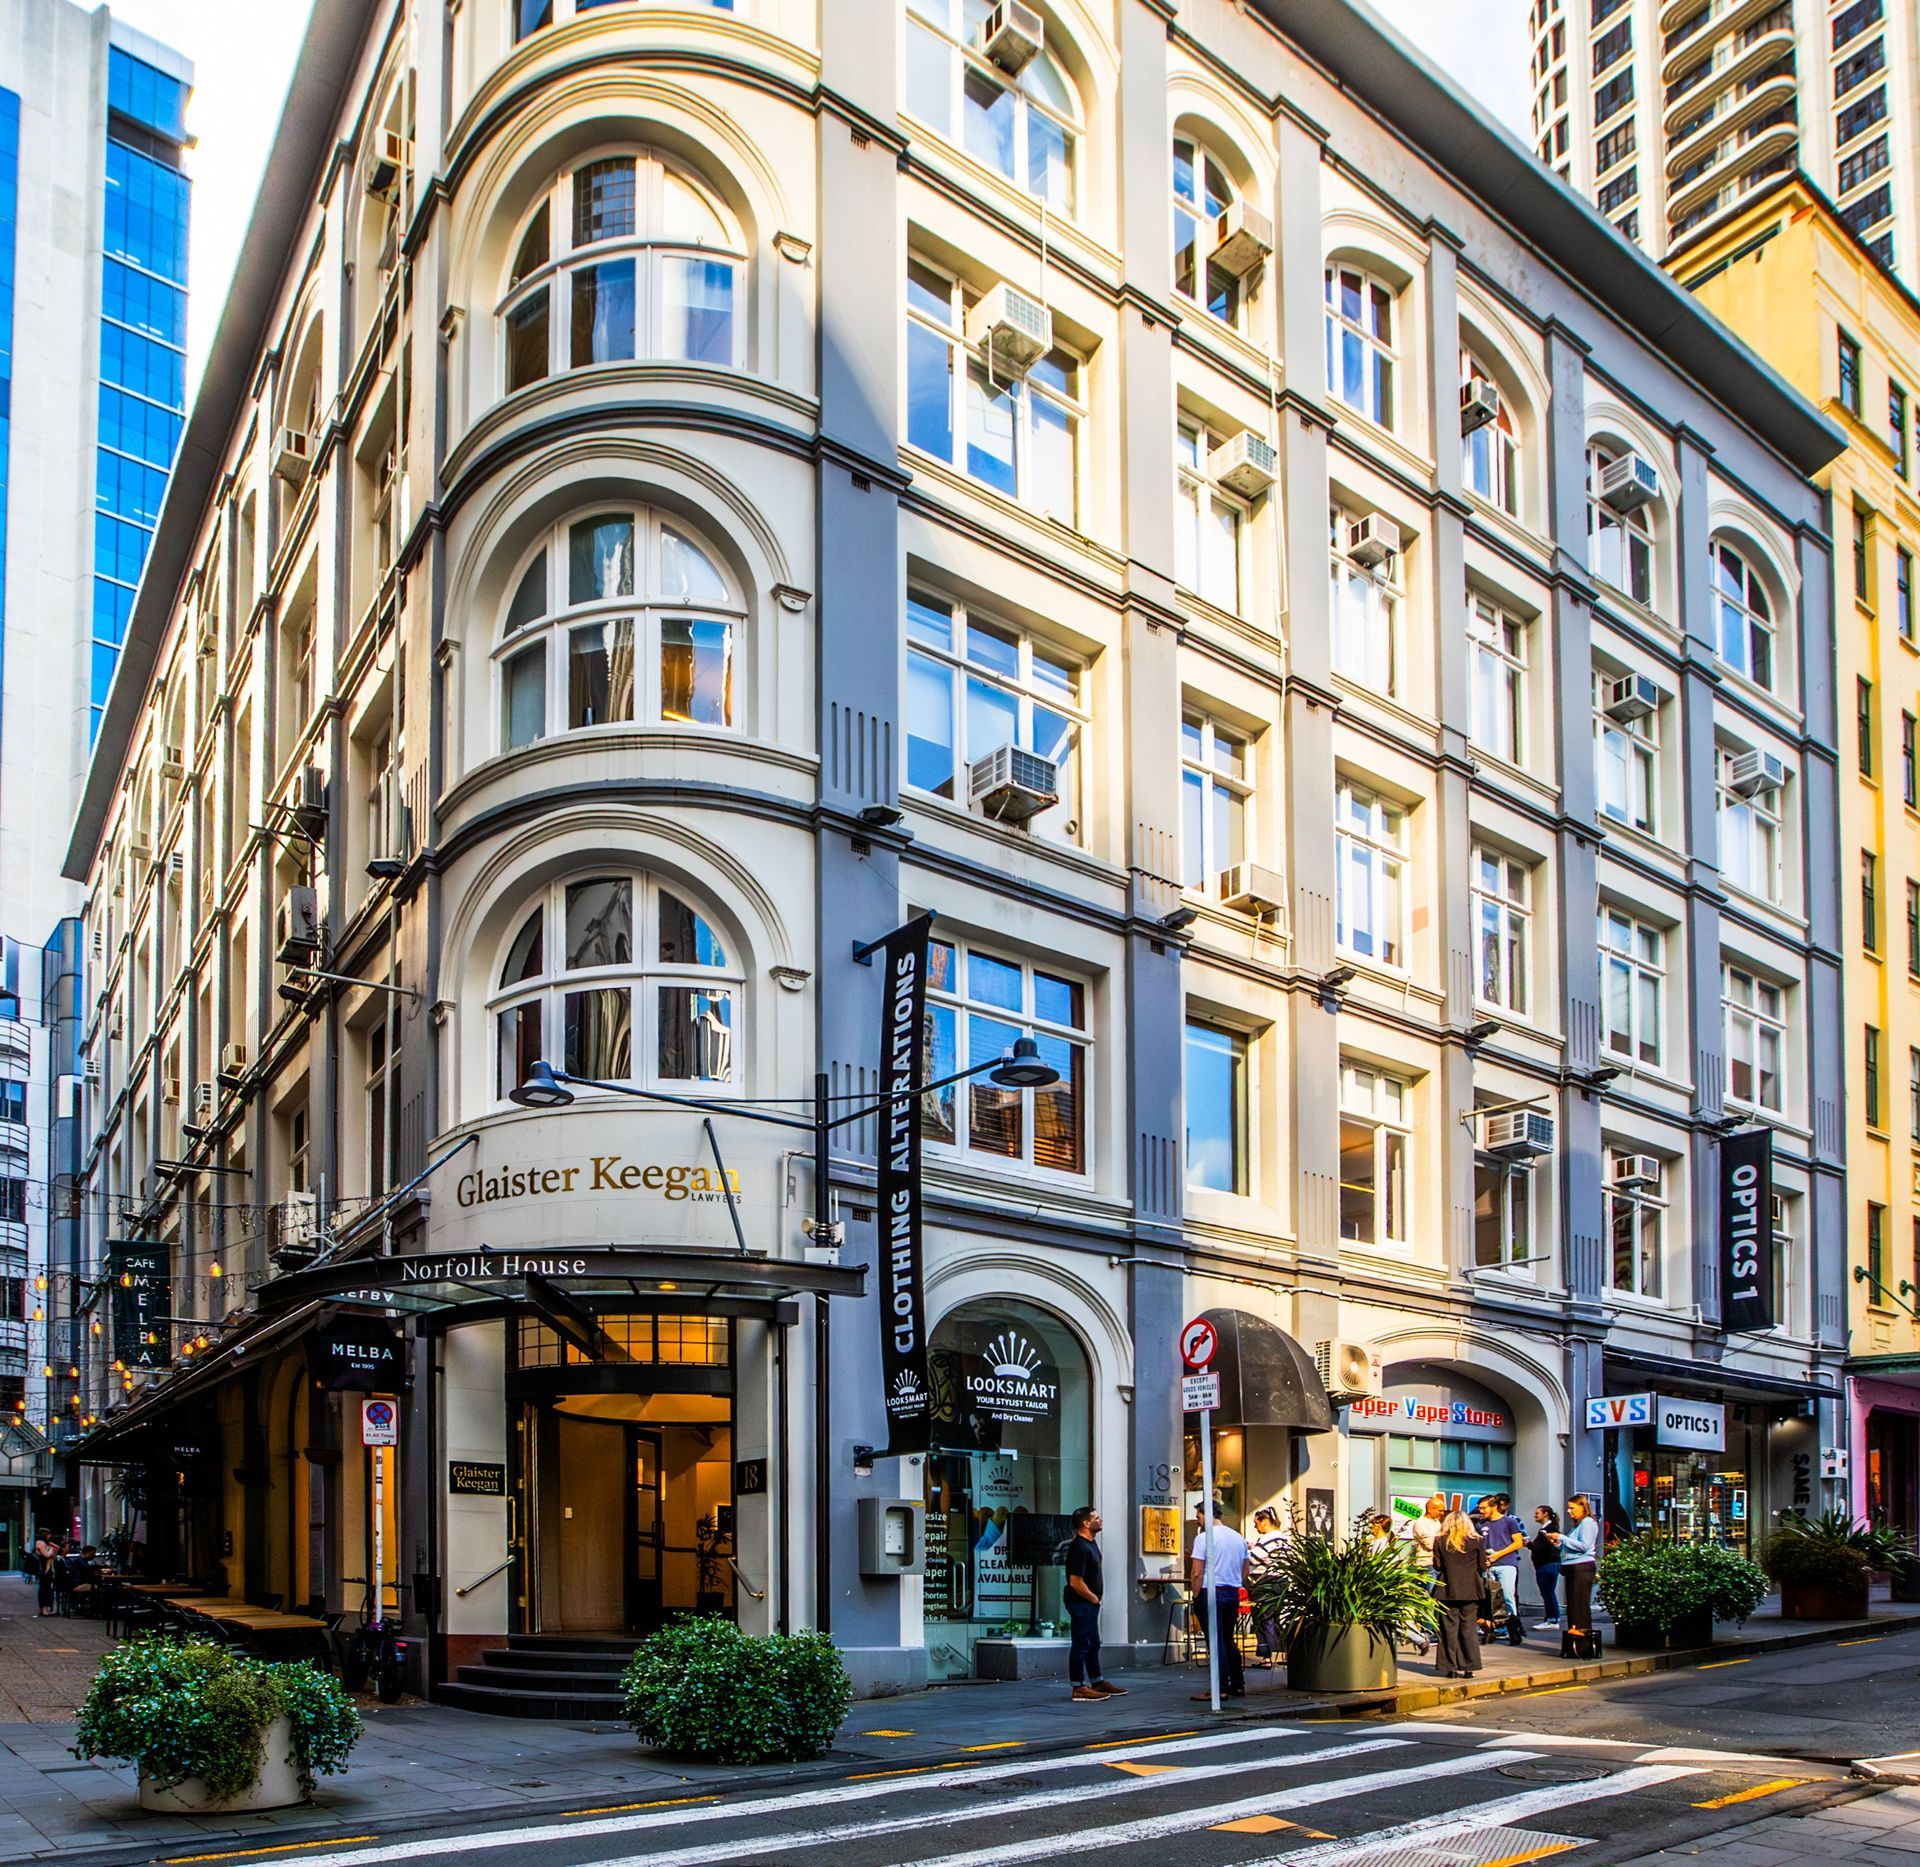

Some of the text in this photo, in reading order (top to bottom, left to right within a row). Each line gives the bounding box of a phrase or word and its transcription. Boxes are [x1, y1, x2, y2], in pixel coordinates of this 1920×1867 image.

[890, 951, 916, 1354] CLOTHING ALTERATIONS
[457, 1156, 742, 1208] Glaister Keegan
[1732, 1164, 1759, 1300] OPTICS 1
[126, 1258, 156, 1269] CAFE
[401, 1255, 586, 1281] Norfolk House
[134, 1274, 152, 1364] MELBA
[332, 1343, 393, 1360] MELBA
[966, 1375, 1057, 1399] LOOKSMART
[886, 1392, 928, 1406] LOOKSMART
[976, 1396, 1048, 1410] YOUR STYLIST TAILOR
[1003, 1414, 1012, 1422] Dry
[1014, 1414, 1034, 1422] Cleaner
[1351, 1396, 1504, 1426] uper Vape Store
[1590, 1398, 1646, 1424] SVS
[1666, 1413, 1718, 1434] OPTICS 1
[453, 1466, 500, 1479] Glaister
[744, 1464, 758, 1489] 18
[1148, 1463, 1171, 1492] 18
[1793, 1454, 1810, 1505] SAME
[456, 1476, 499, 1492] Keegan
[1142, 1494, 1178, 1505] HIGH ST
[925, 1512, 948, 1521] esize
[1394, 1500, 1421, 1519] LEASED
[925, 1531, 948, 1542] epair
[1160, 1528, 1176, 1538] SUM
[925, 1545, 948, 1554] estyle
[994, 1545, 1008, 1555] DR
[925, 1568, 948, 1580] aper
[978, 1574, 1032, 1584] AVAILABLE
